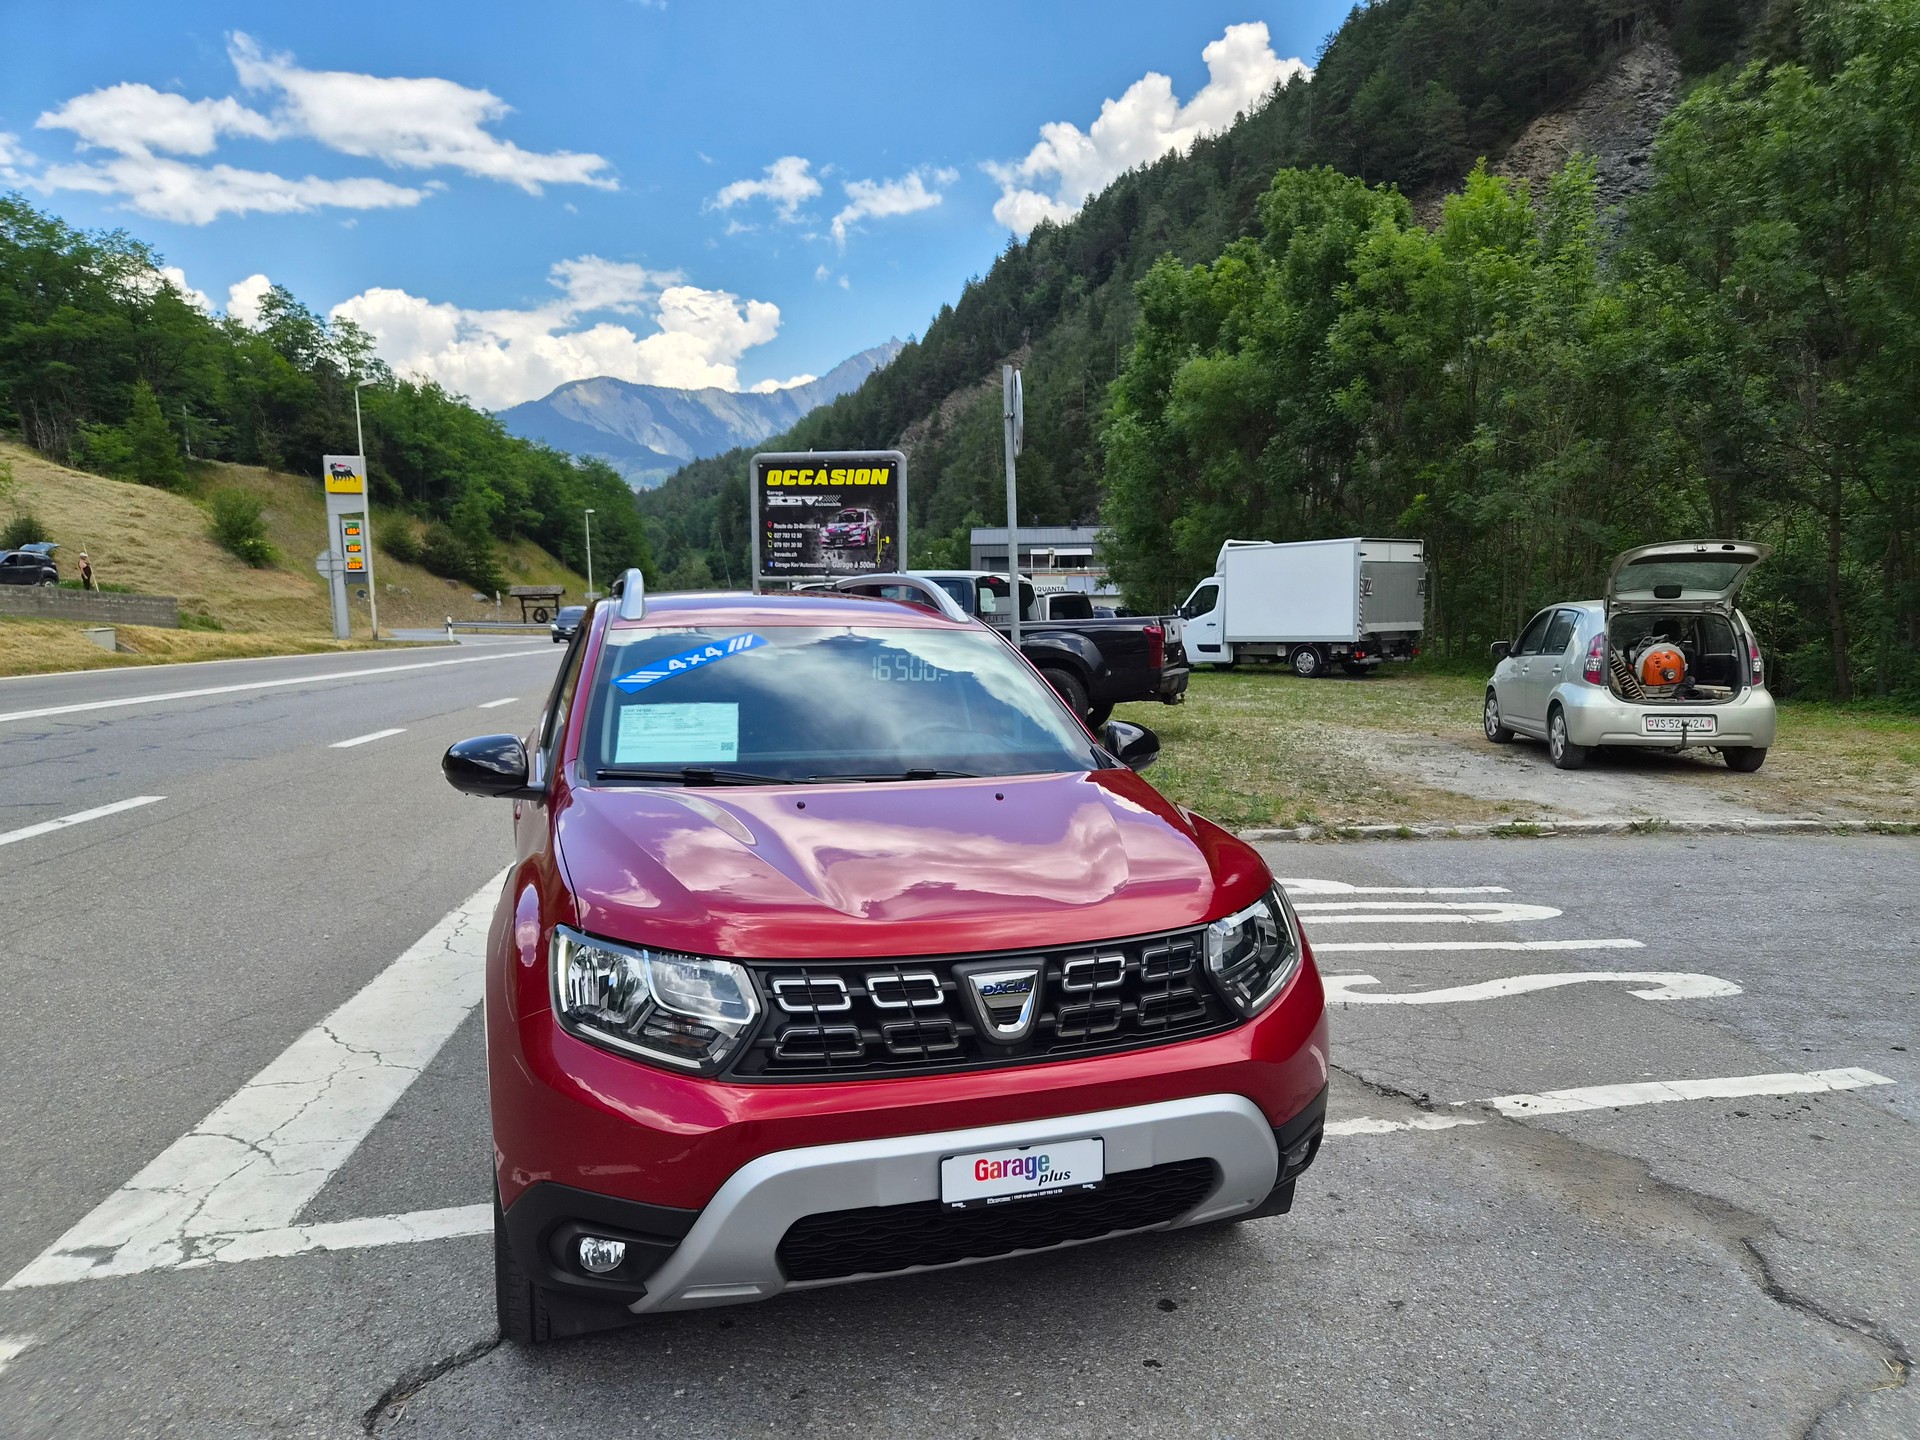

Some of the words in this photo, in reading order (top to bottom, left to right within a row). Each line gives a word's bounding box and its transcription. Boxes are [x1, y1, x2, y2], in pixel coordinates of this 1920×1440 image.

[766, 468, 889, 486] OCCASION
[831, 561, 854, 570] Garage
[859, 561, 876, 569] 500m
[983, 982, 1031, 996] DACIA
[974, 1153, 1050, 1182] Garage
[1038, 1169, 1072, 1186] plus
